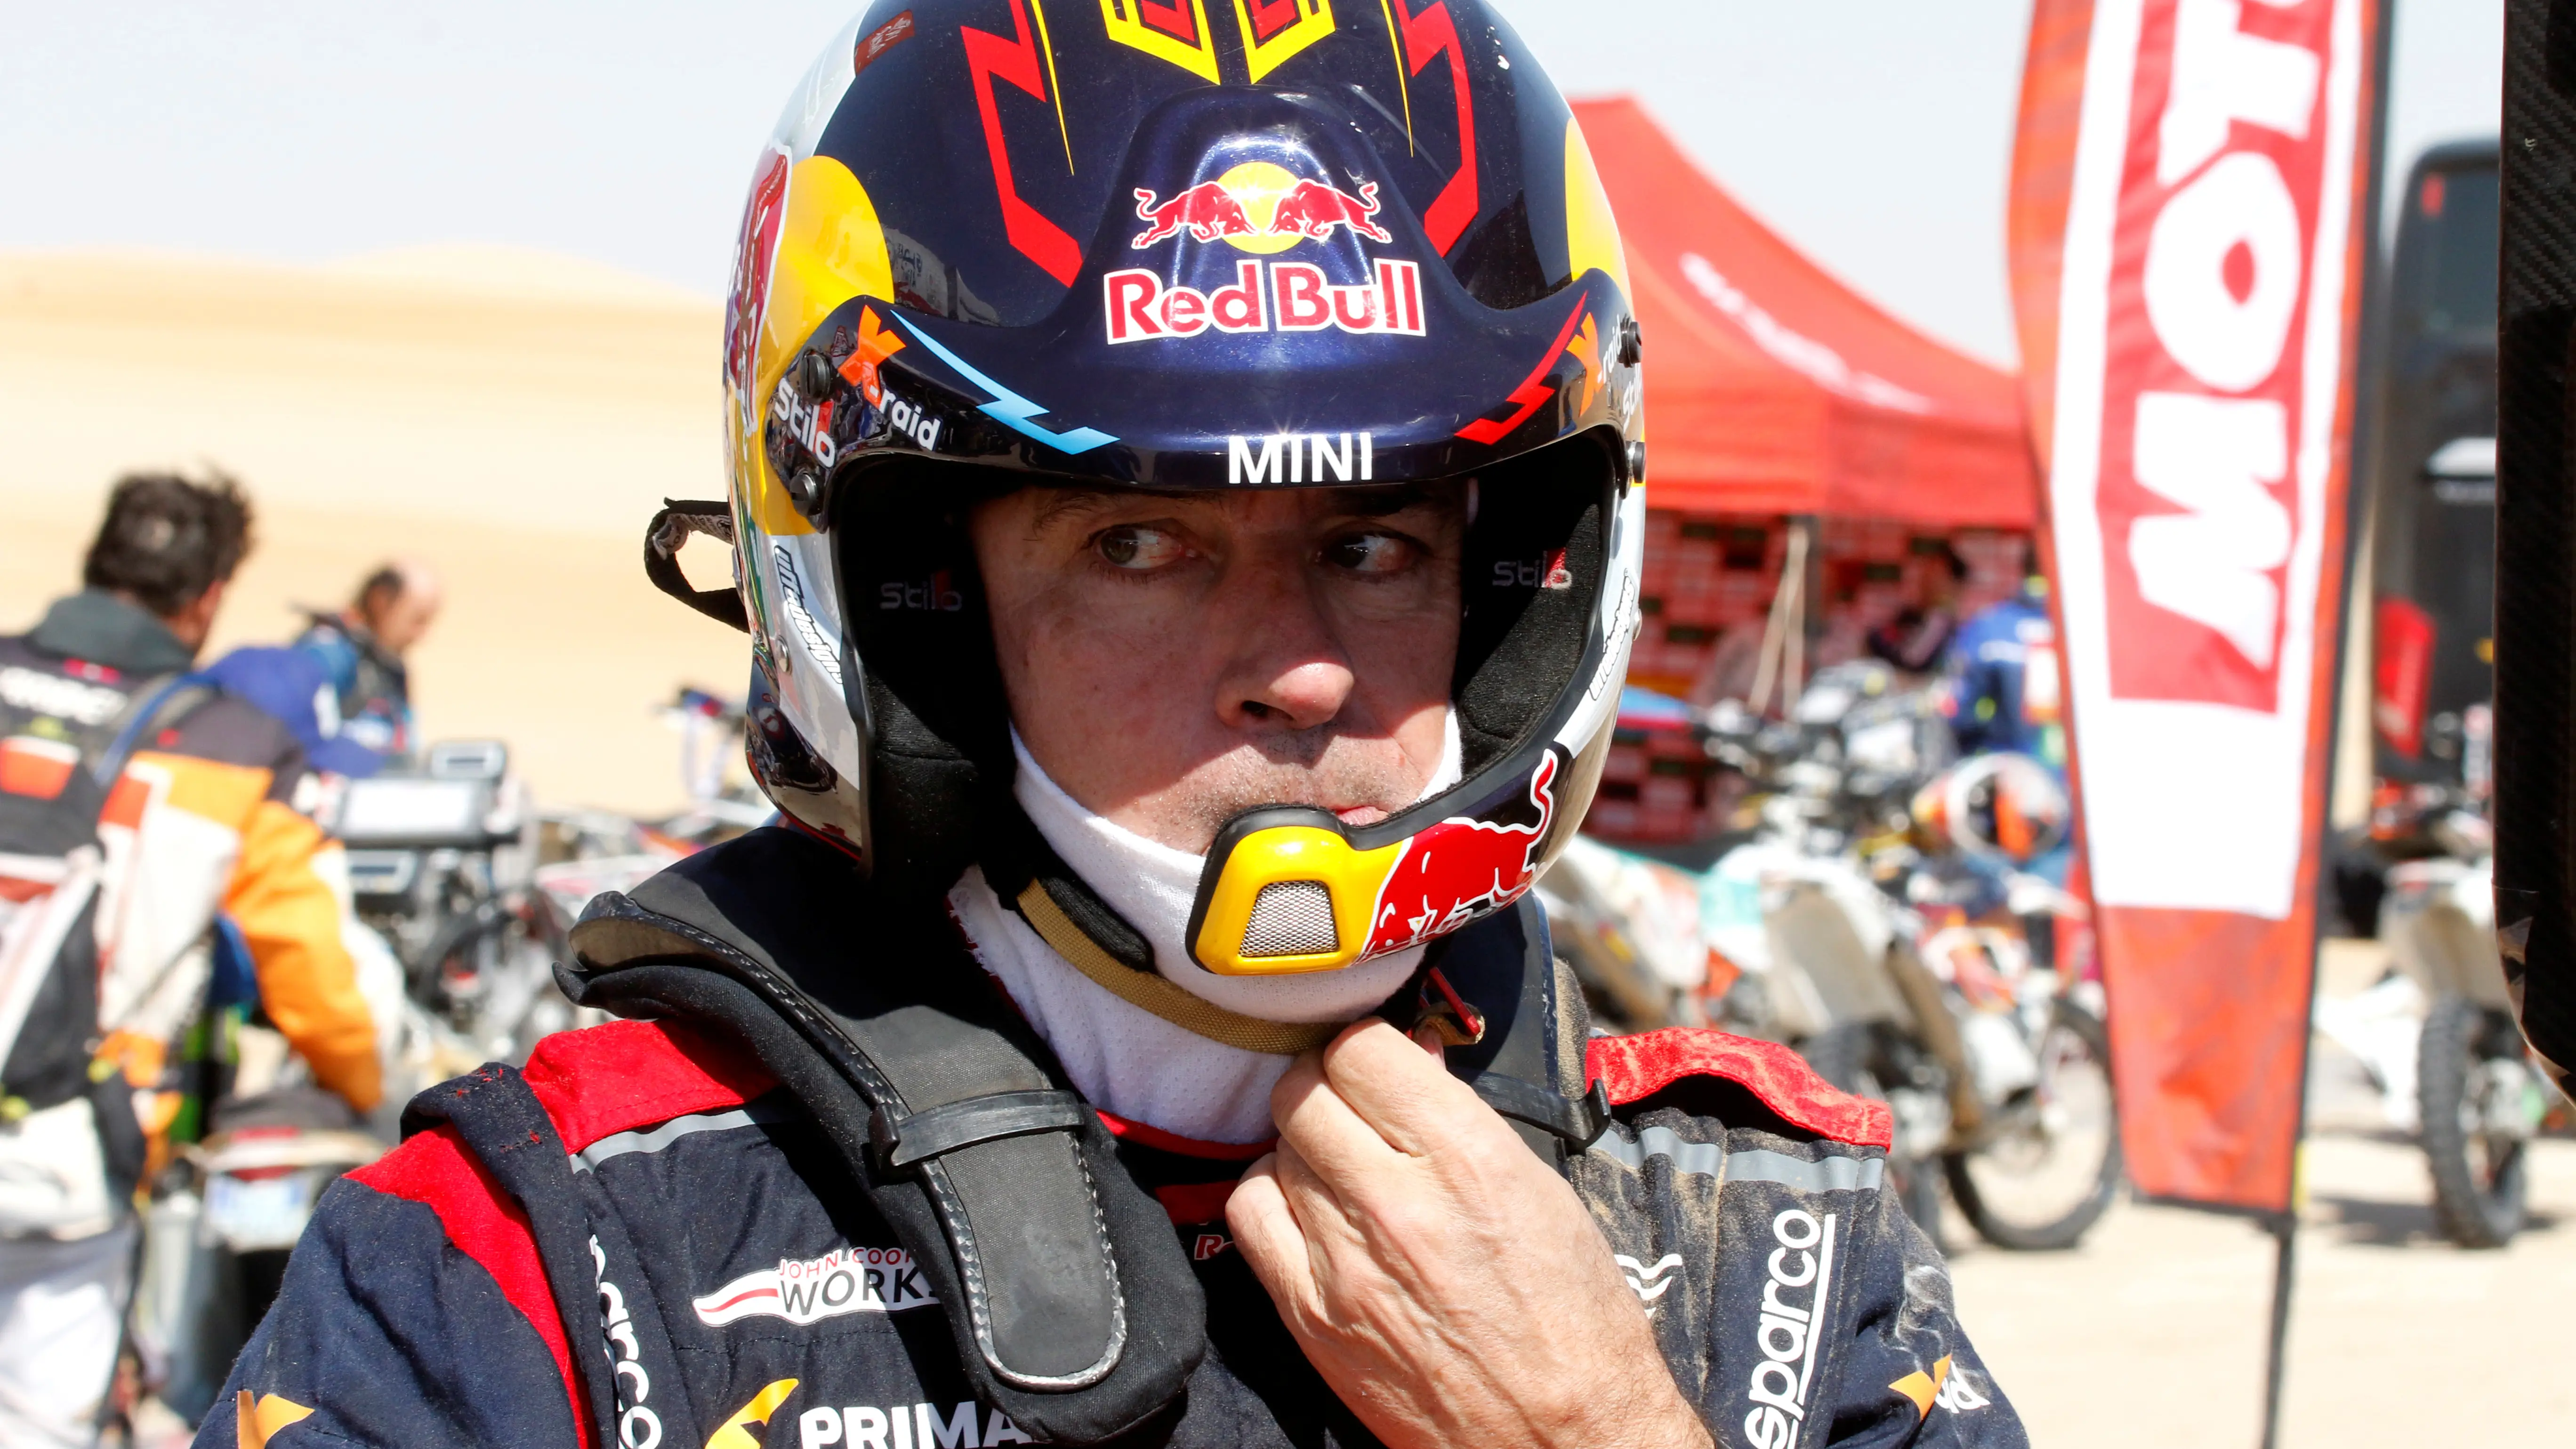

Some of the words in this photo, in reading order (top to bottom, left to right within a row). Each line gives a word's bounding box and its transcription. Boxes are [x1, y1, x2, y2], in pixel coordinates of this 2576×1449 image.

[1105, 260, 1267, 344] Red
[1270, 258, 1426, 336] Bull
[2129, 0, 2320, 671] MOT
[775, 378, 835, 467] Stilo
[1229, 433, 1372, 484] MINI
[879, 572, 962, 612] Stilo
[1492, 548, 1572, 590] Stilo
[780, 1252, 838, 1279] JOHN
[781, 1265, 936, 1316] WORK
